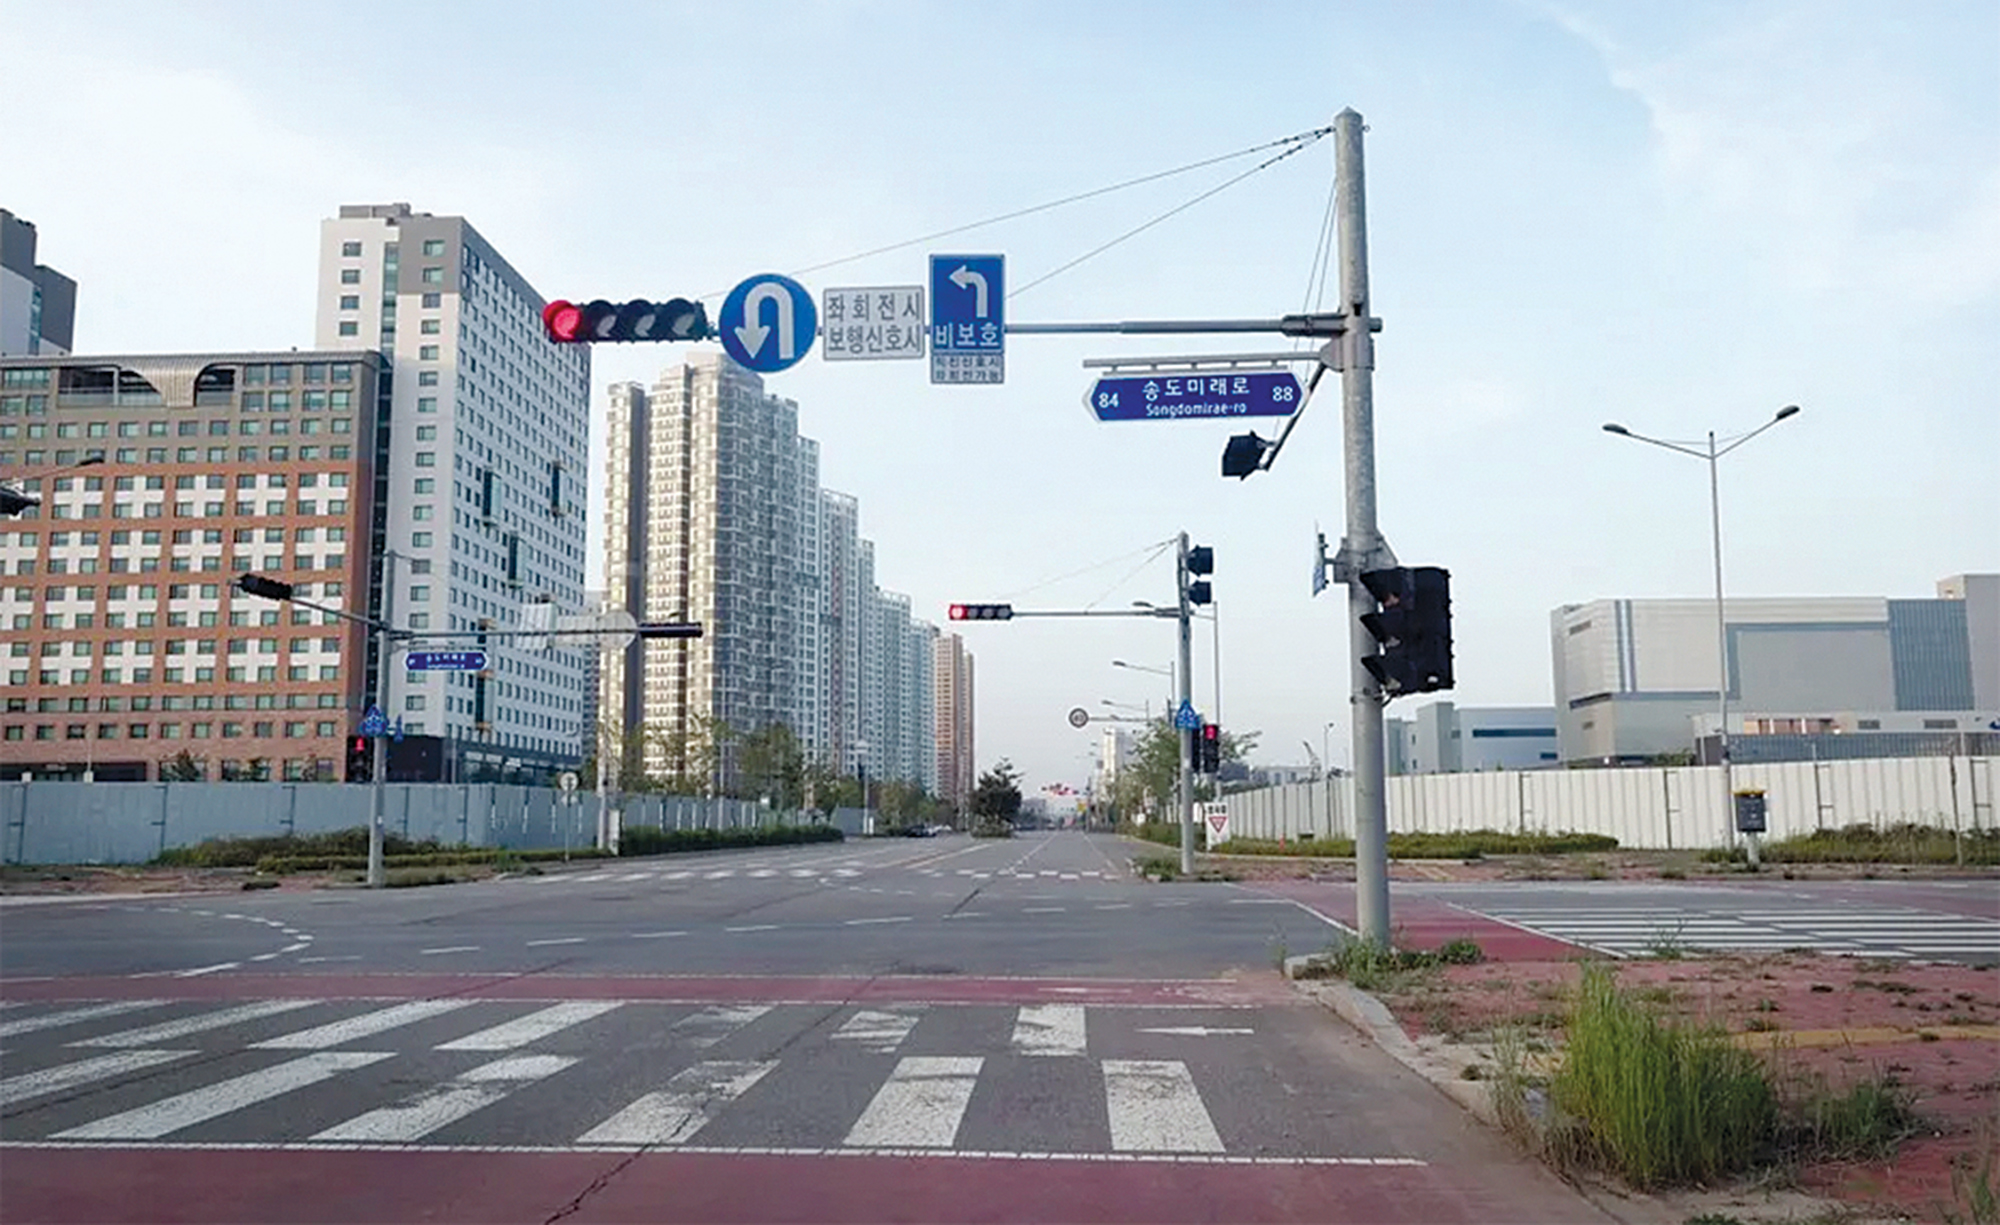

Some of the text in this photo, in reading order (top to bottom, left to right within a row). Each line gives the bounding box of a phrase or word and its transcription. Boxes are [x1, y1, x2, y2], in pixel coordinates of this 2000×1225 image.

[827, 325, 921, 354] 보행신호시
[935, 322, 999, 349] 비보호
[1142, 377, 1250, 401] 송도미래로
[1272, 386, 1294, 402] 88
[1098, 392, 1119, 409] 84
[1145, 403, 1248, 418] Songdomirae-ro
